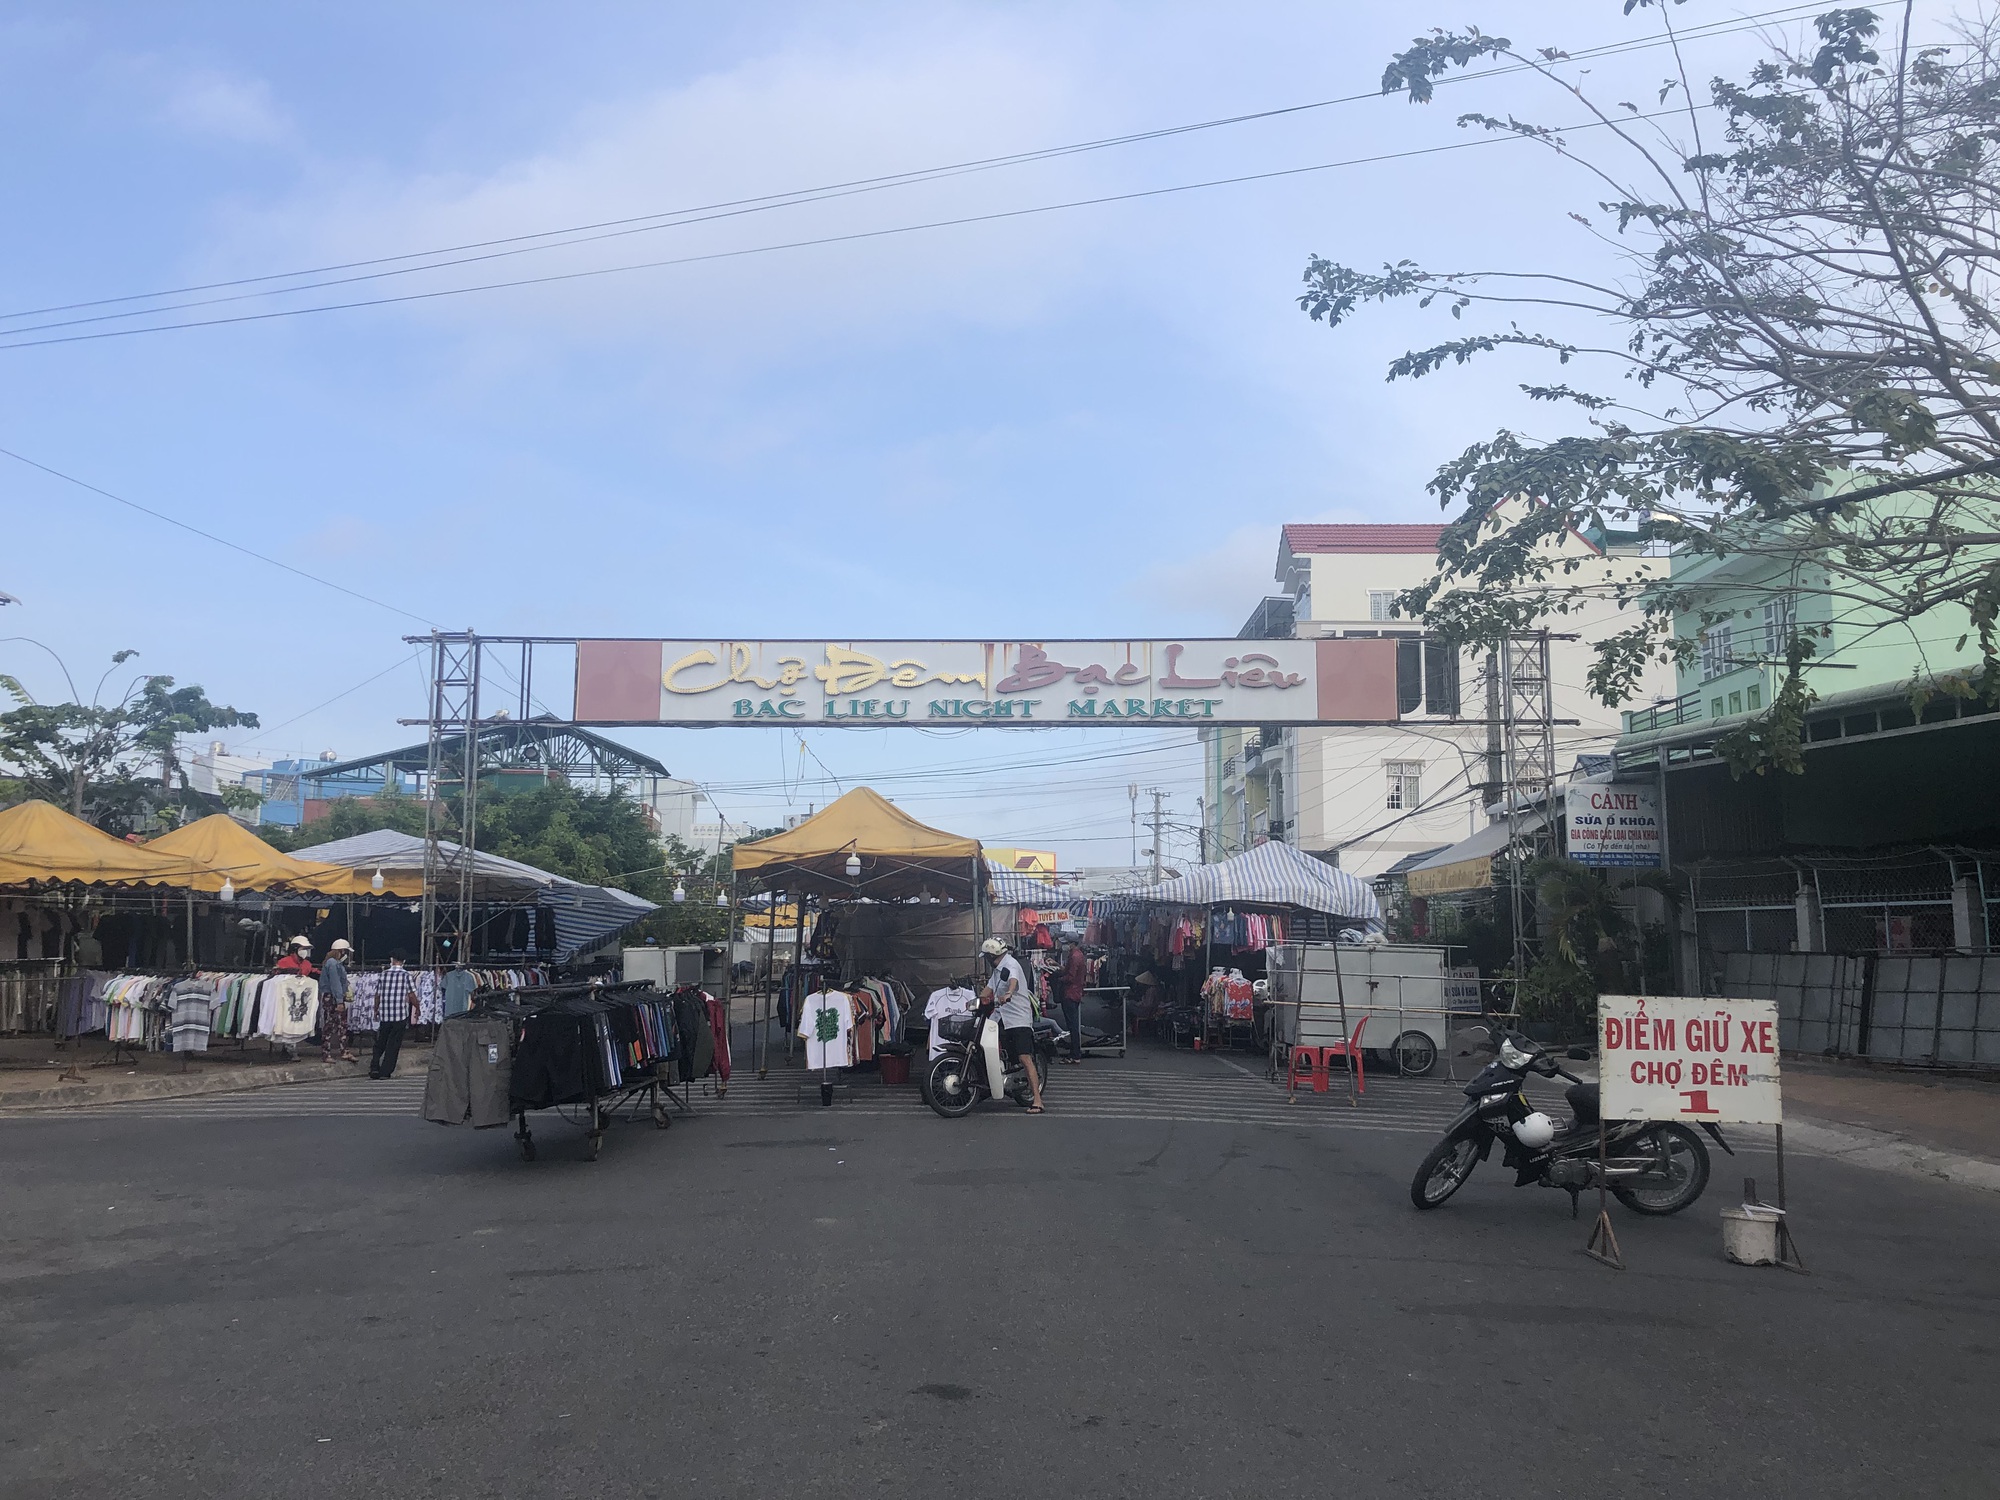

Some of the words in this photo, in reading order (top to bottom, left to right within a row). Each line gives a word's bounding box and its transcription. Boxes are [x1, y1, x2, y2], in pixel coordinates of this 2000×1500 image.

[663, 643, 808, 696] Chợ
[814, 643, 987, 696] Đêm
[996, 643, 1150, 695] Bạc
[1159, 643, 1307, 689] Liêu
[733, 698, 806, 718] BAC
[824, 698, 910, 718] LIEU
[929, 698, 1042, 718] NIGHT
[1067, 698, 1224, 718] MARKET
[1591, 787, 1638, 810] CẢNH
[1575, 813, 1602, 825] SỬA
[1620, 815, 1656, 826] KHÓA
[1571, 829, 1581, 840] GIA
[1582, 827, 1598, 840] CÔNG
[1613, 830, 1627, 842] LOẠI
[1038, 909, 1055, 921] TUYẾT
[1057, 912, 1068, 920] NGA
[1605, 999, 1676, 1051] ĐIỂM
[1685, 1010, 1732, 1053] GIỮ
[1740, 1021, 1775, 1054] XE
[1631, 1058, 1683, 1089] CHỢ
[1691, 1058, 1748, 1087] ĐÊM
[1679, 1090, 1720, 1114] 1
